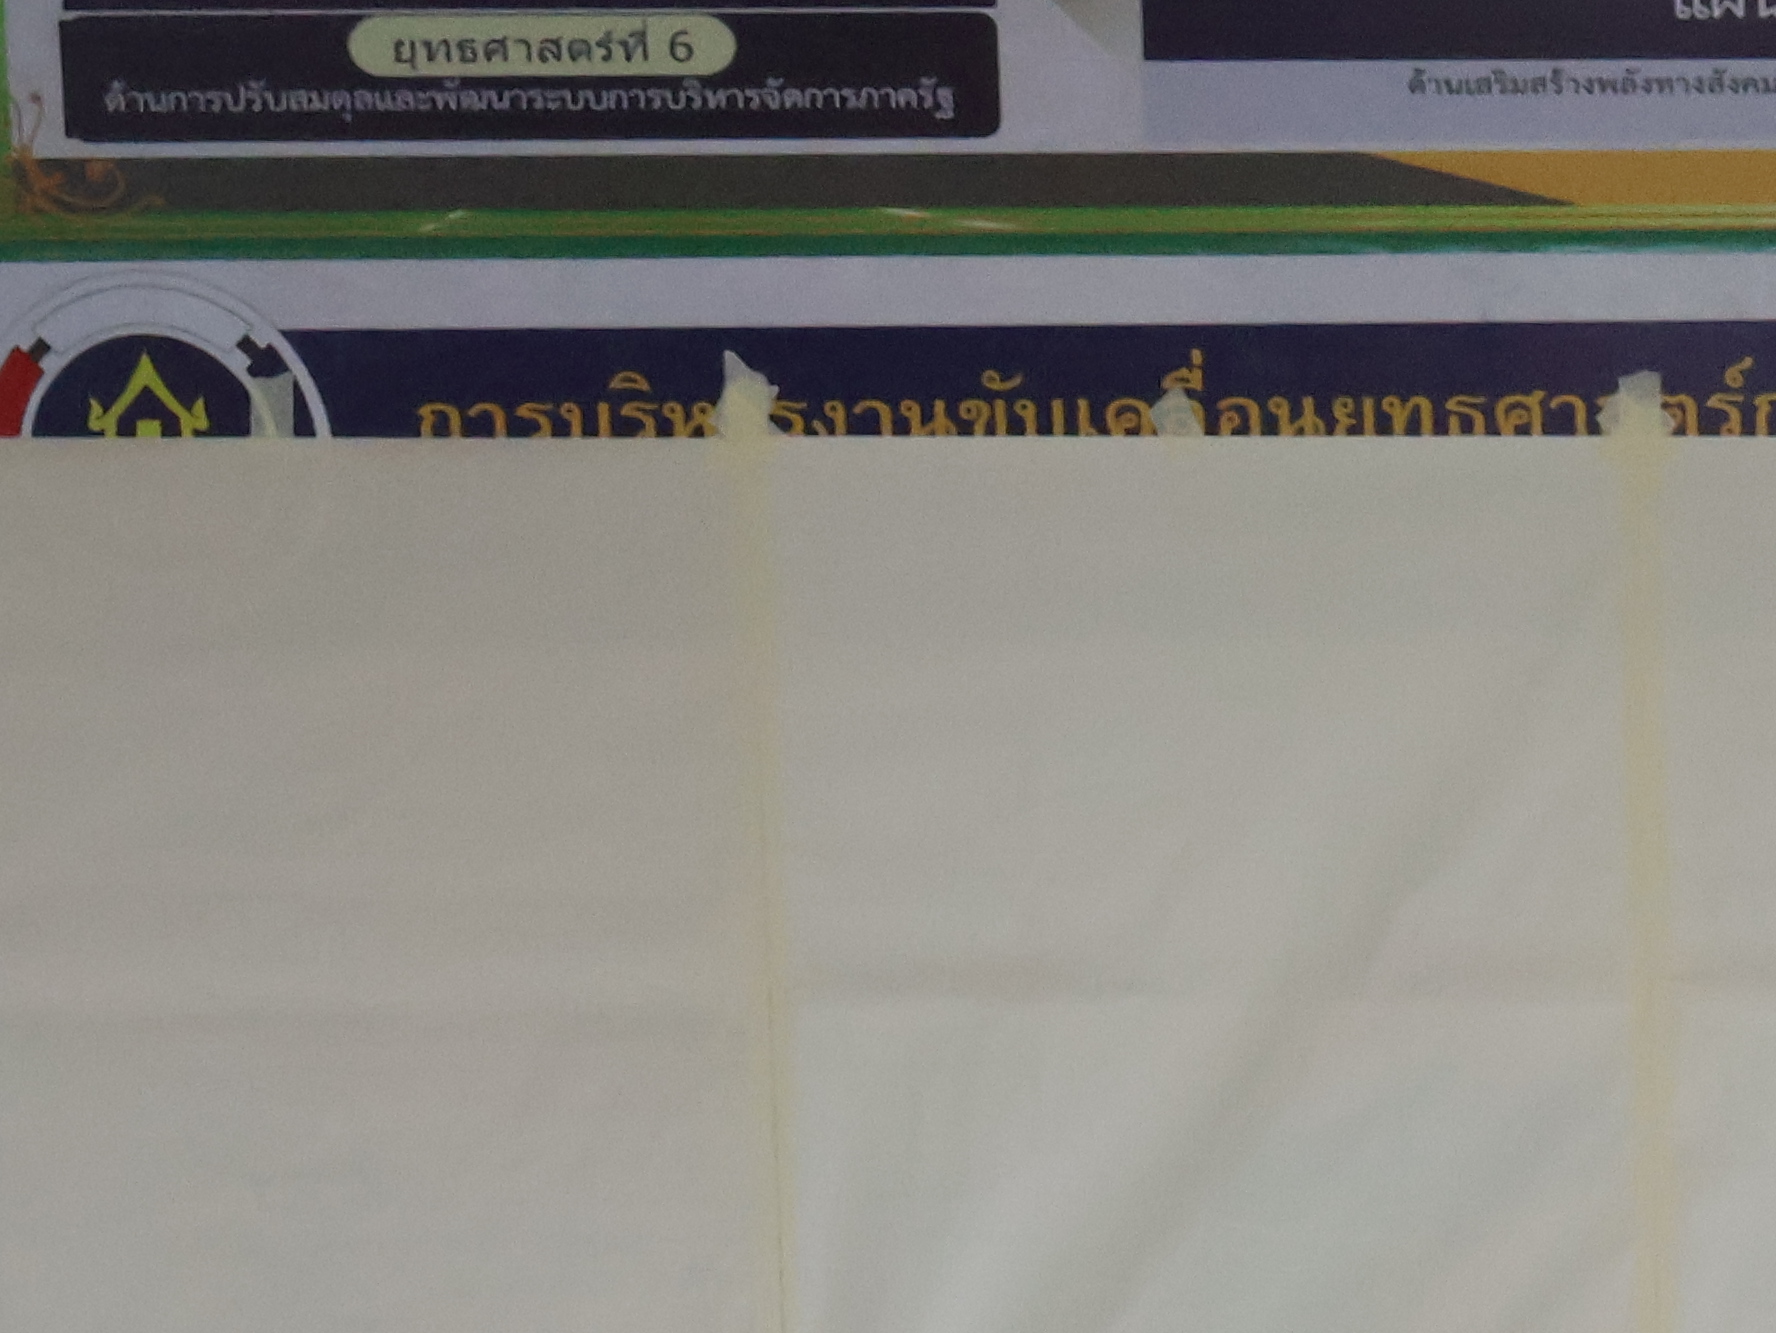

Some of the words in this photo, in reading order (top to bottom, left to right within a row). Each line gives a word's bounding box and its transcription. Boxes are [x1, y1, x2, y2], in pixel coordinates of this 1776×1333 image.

[392, 18, 650, 69] ยุทธศาสตร์ที่
[668, 29, 695, 63] 6
